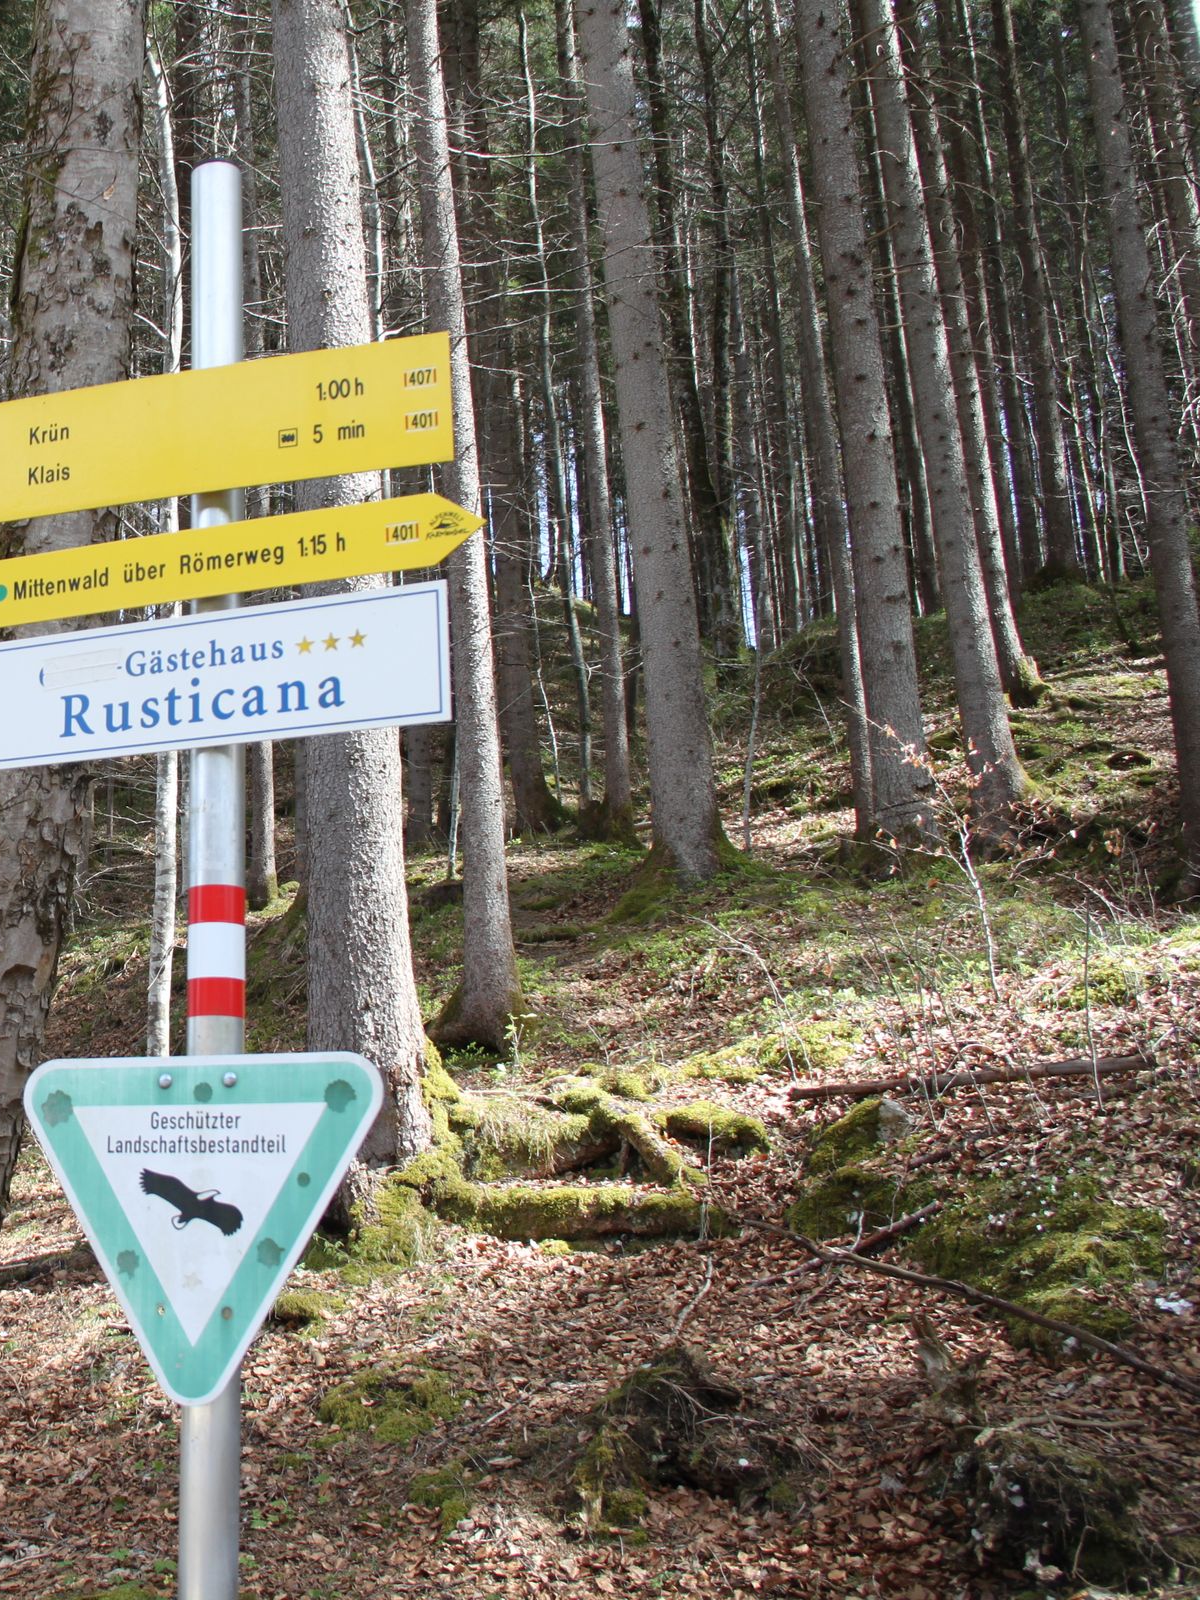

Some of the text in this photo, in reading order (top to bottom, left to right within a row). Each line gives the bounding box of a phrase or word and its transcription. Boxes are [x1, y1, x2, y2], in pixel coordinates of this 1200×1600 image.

[316, 377, 364, 401] 1:00 h
[408, 369, 433, 386] 407
[312, 419, 365, 444] 5 min
[411, 411, 434, 429] 401
[29, 423, 70, 446] Krün
[28, 463, 71, 486] Klais
[392, 523, 414, 541] 401
[13, 532, 346, 601] Mittenwald über Römerweg 1:15 h
[59, 676, 343, 738] Rusticana
[150, 1111, 241, 1131] Geschützter
[107, 1134, 287, 1155] Landschaftsbestandteil
